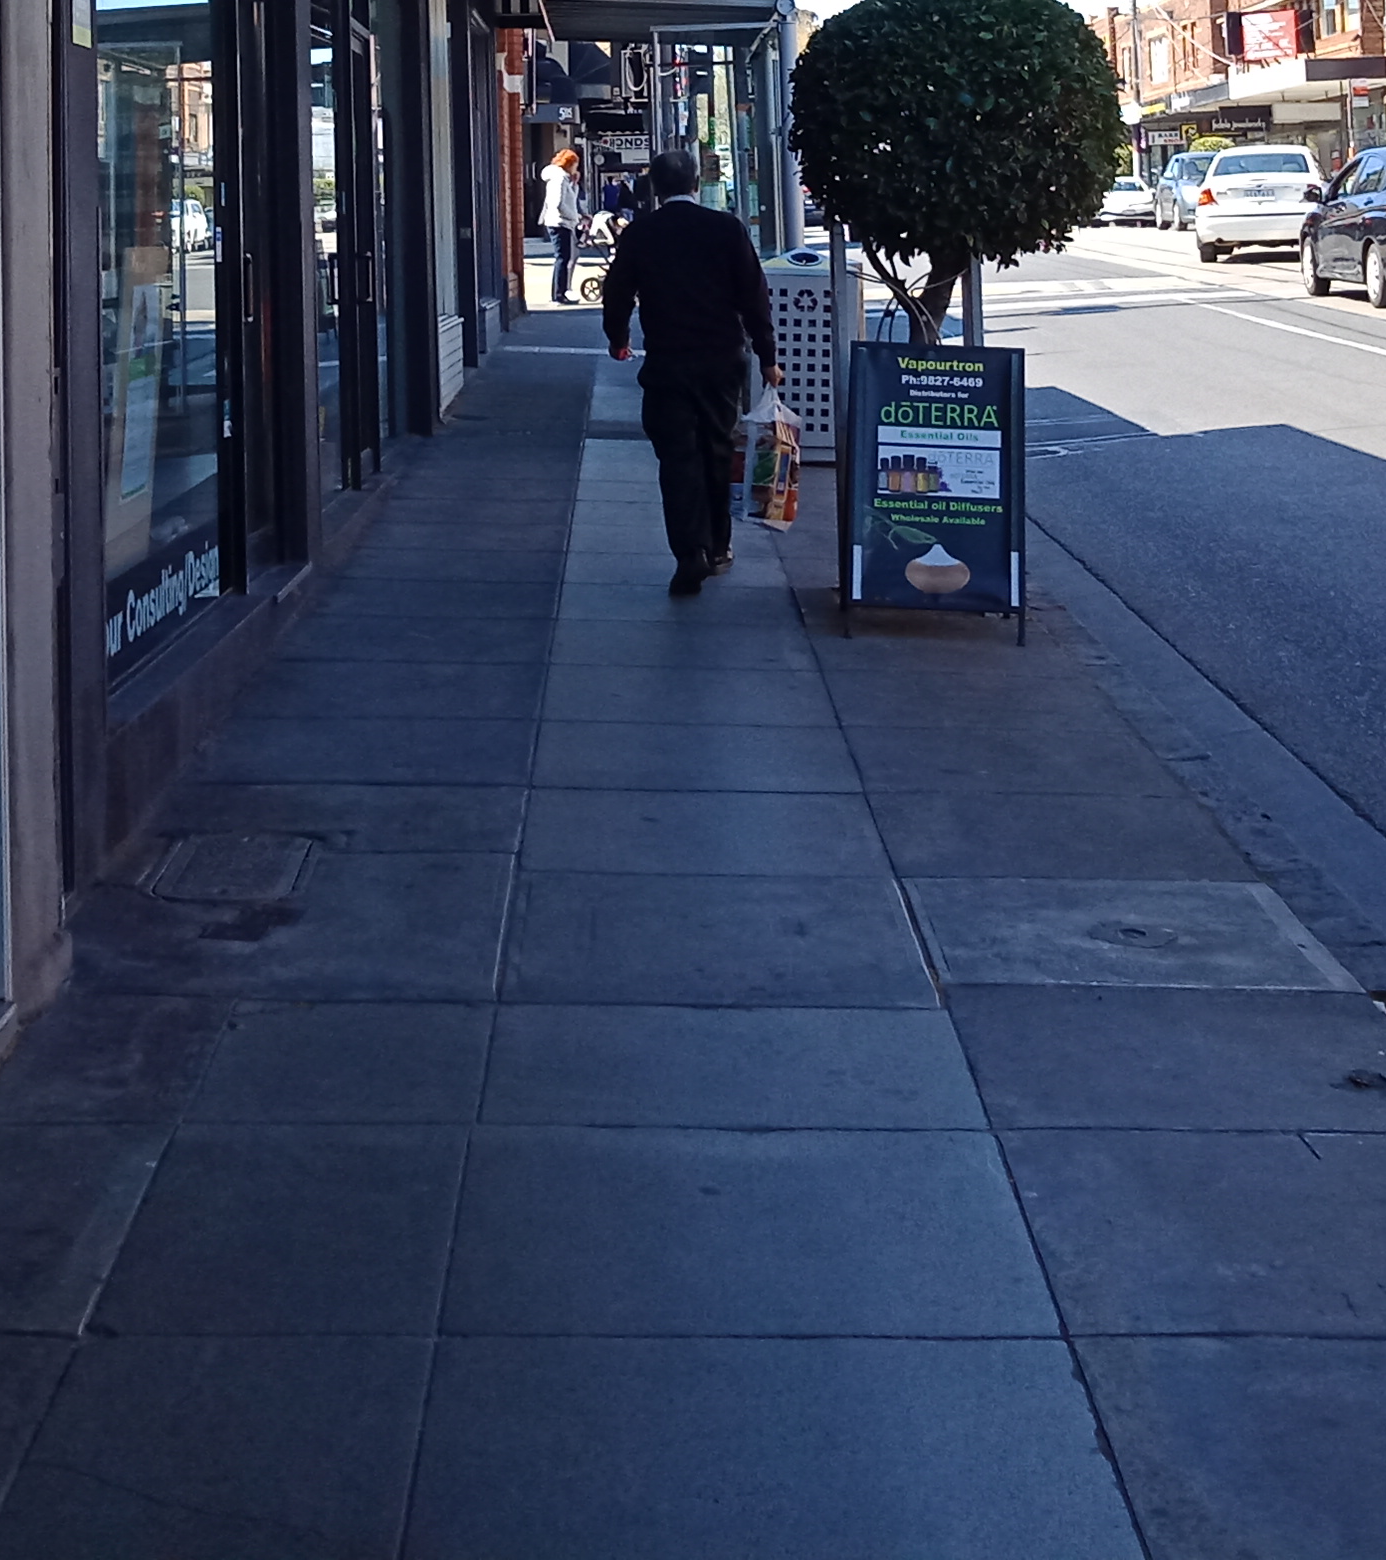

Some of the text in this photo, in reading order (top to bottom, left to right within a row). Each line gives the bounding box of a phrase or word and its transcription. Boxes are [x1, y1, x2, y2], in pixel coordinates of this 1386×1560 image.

[897, 357, 984, 372] Vapourtron
[900, 430, 980, 442] Essential Oils
[873, 498, 1004, 513] Essential oil Diffusers
